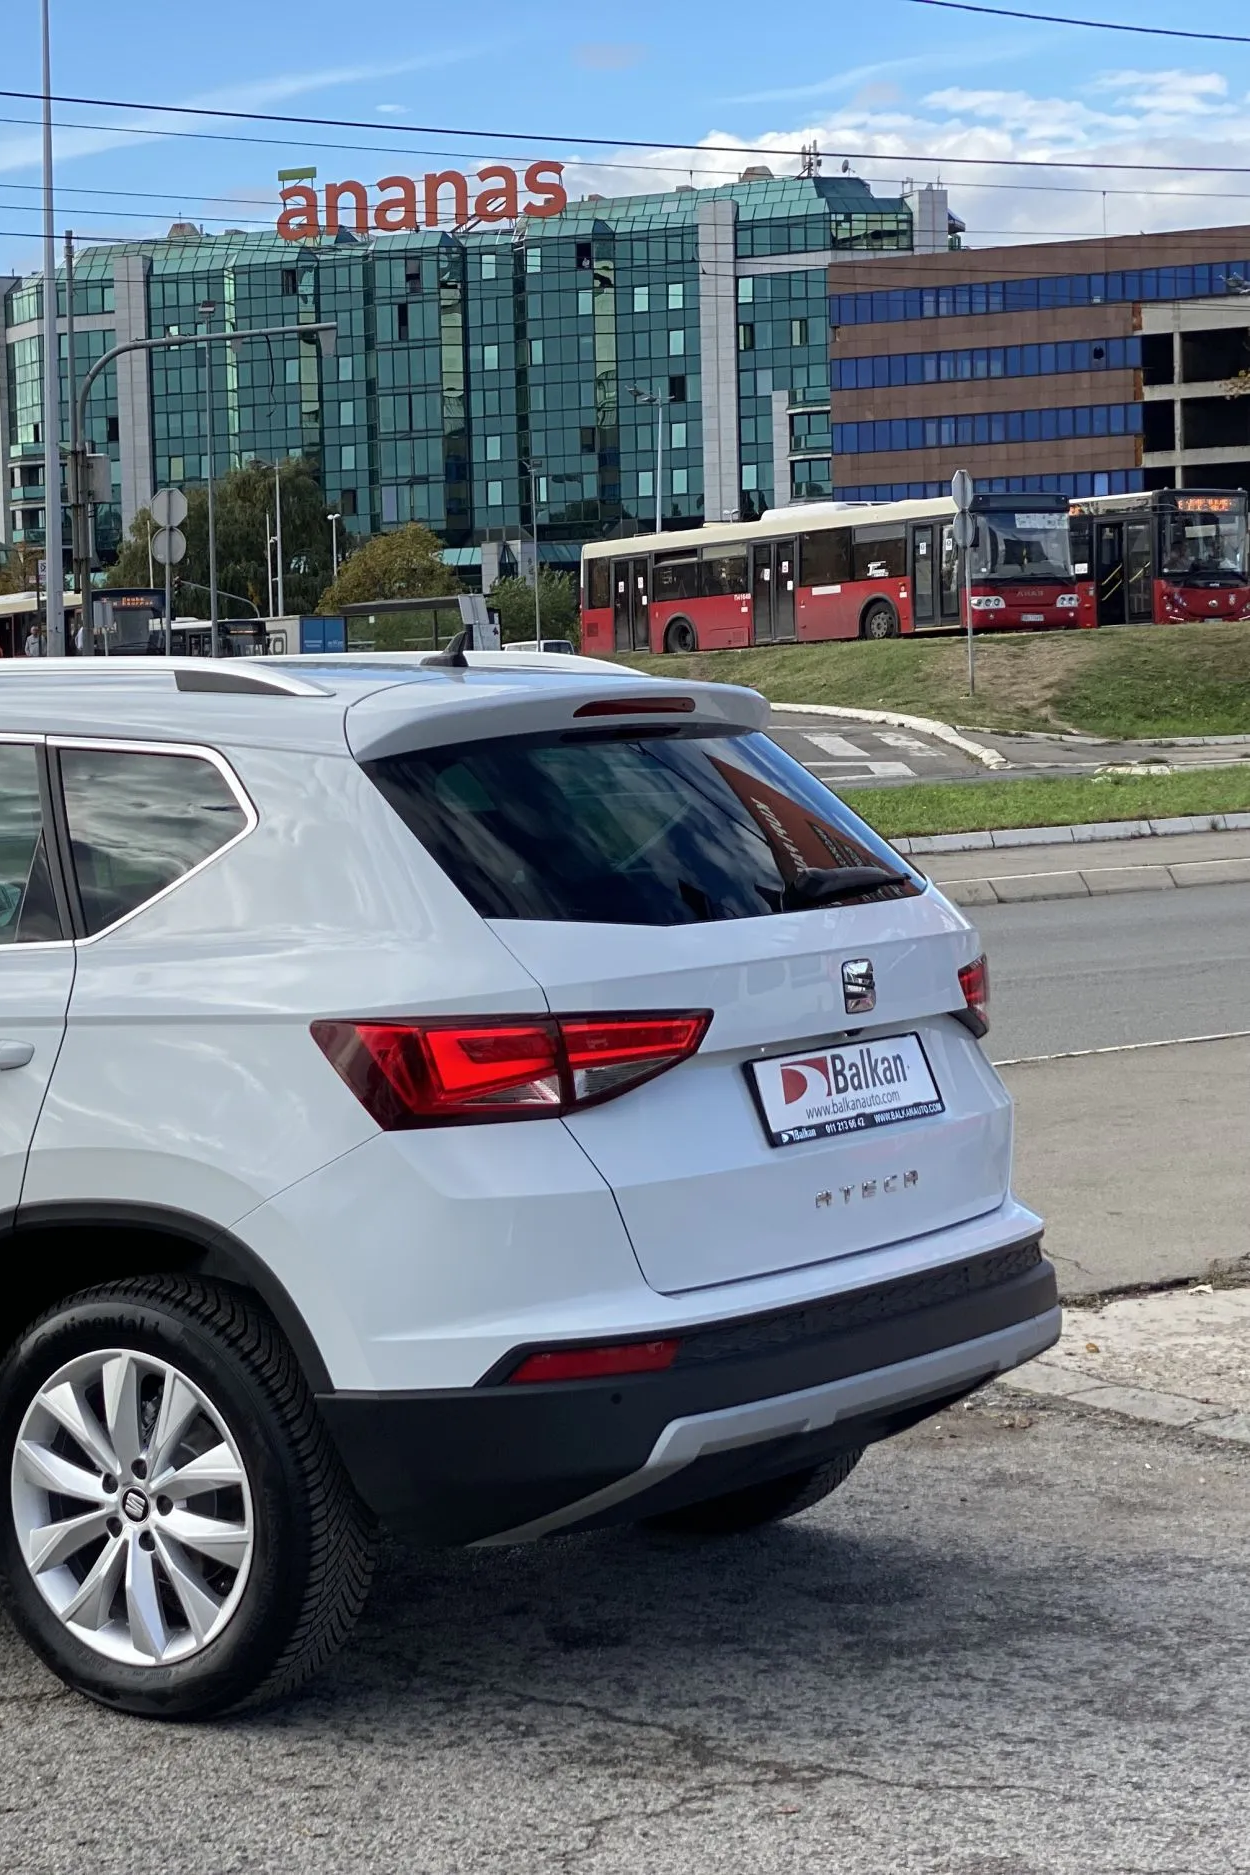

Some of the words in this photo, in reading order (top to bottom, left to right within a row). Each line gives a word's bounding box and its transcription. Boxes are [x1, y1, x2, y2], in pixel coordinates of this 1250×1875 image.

[830, 1047, 908, 1095] Balkan
[795, 1127, 817, 1140] Balkan
[825, 1124, 837, 1134] 011
[837, 1121, 848, 1132] 213
[857, 1117, 865, 1128] 42
[873, 1102, 942, 1124] WWW.BALKANAUTO.COM
[805, 1089, 901, 1121] www.balkanauto.com
[815, 1170, 919, 1209] ATECA
